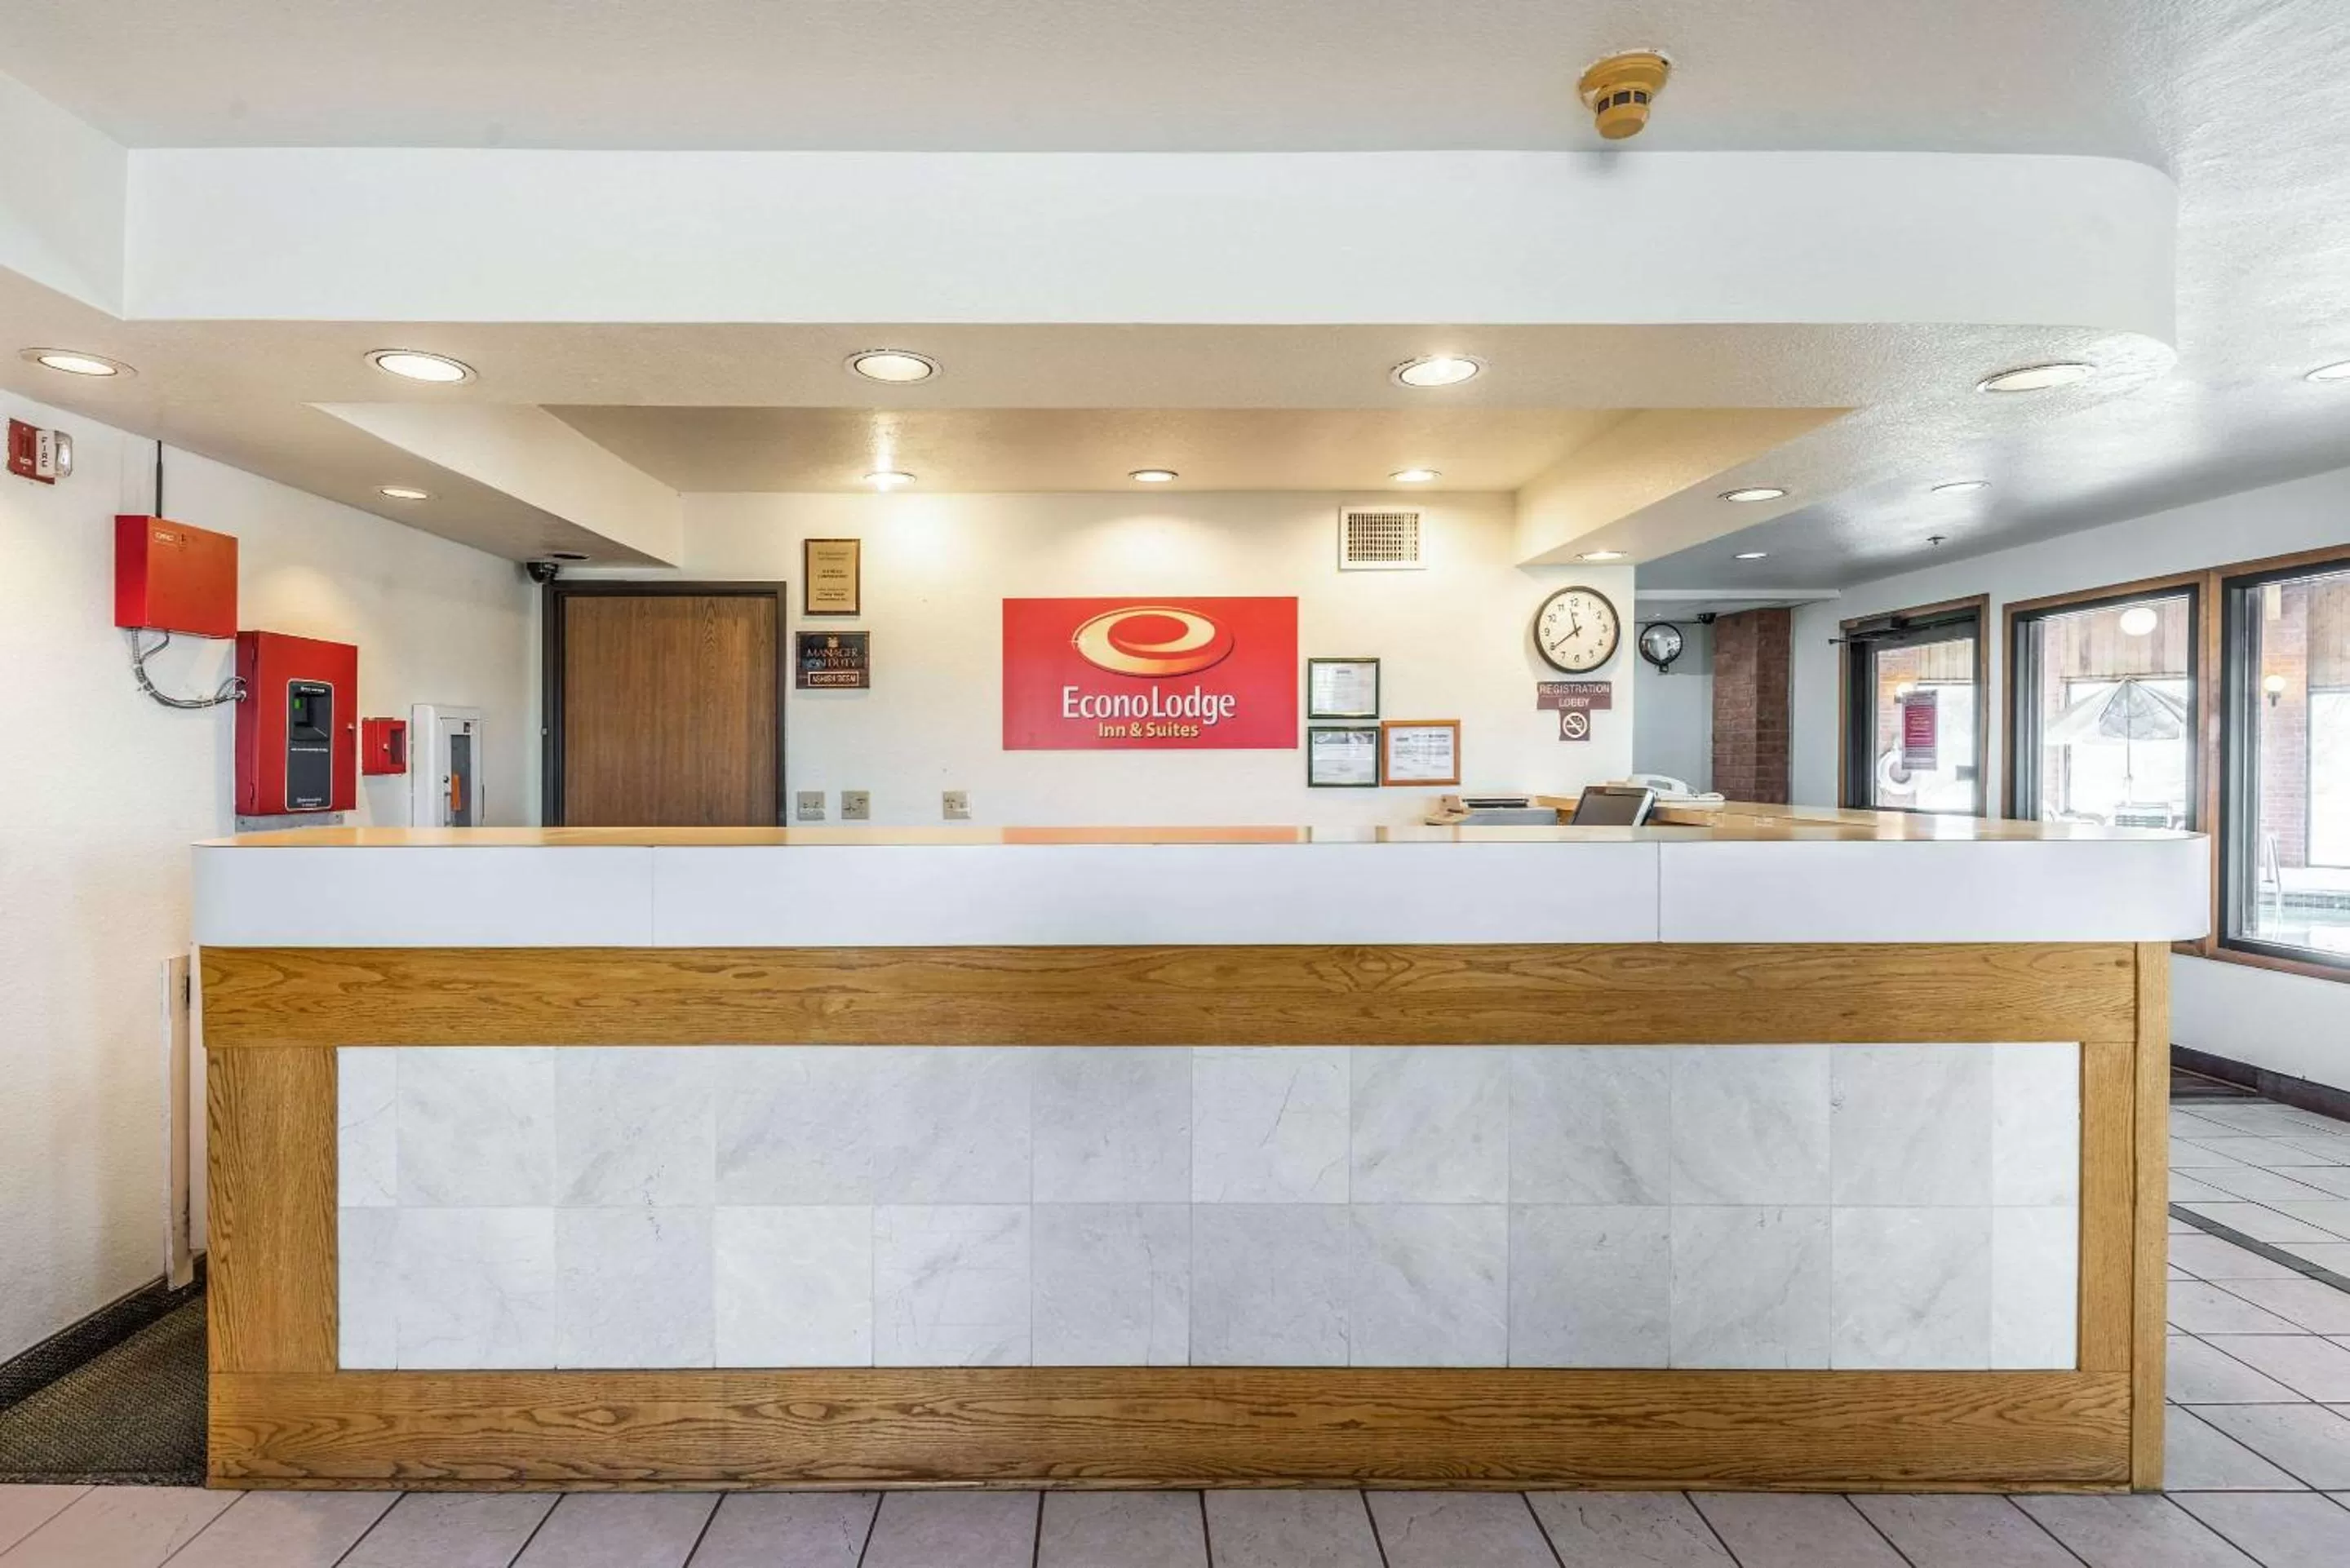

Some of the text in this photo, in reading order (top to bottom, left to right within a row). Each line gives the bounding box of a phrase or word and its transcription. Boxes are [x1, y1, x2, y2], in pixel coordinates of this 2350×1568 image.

[1570, 597, 1579, 608] 12
[1587, 600, 1591, 610] 1
[1558, 604, 1564, 612] 11
[1547, 613, 1557, 622] 10
[1595, 610, 1602, 620] 2
[1544, 627, 1550, 636] 9
[1602, 624, 1608, 634] 3
[1550, 641, 1556, 651] 8
[1597, 638, 1603, 646] 4
[806, 649, 858, 658] MANAGER
[1561, 651, 1566, 659] 7
[1589, 649, 1594, 659] 5
[807, 658, 856, 667] ON DUTY
[1573, 654, 1580, 663] 6
[1539, 684, 1610, 695] REGISTRATION
[1558, 698, 1590, 707] LOBBY
[1098, 721, 1199, 737] Inn & Suites
